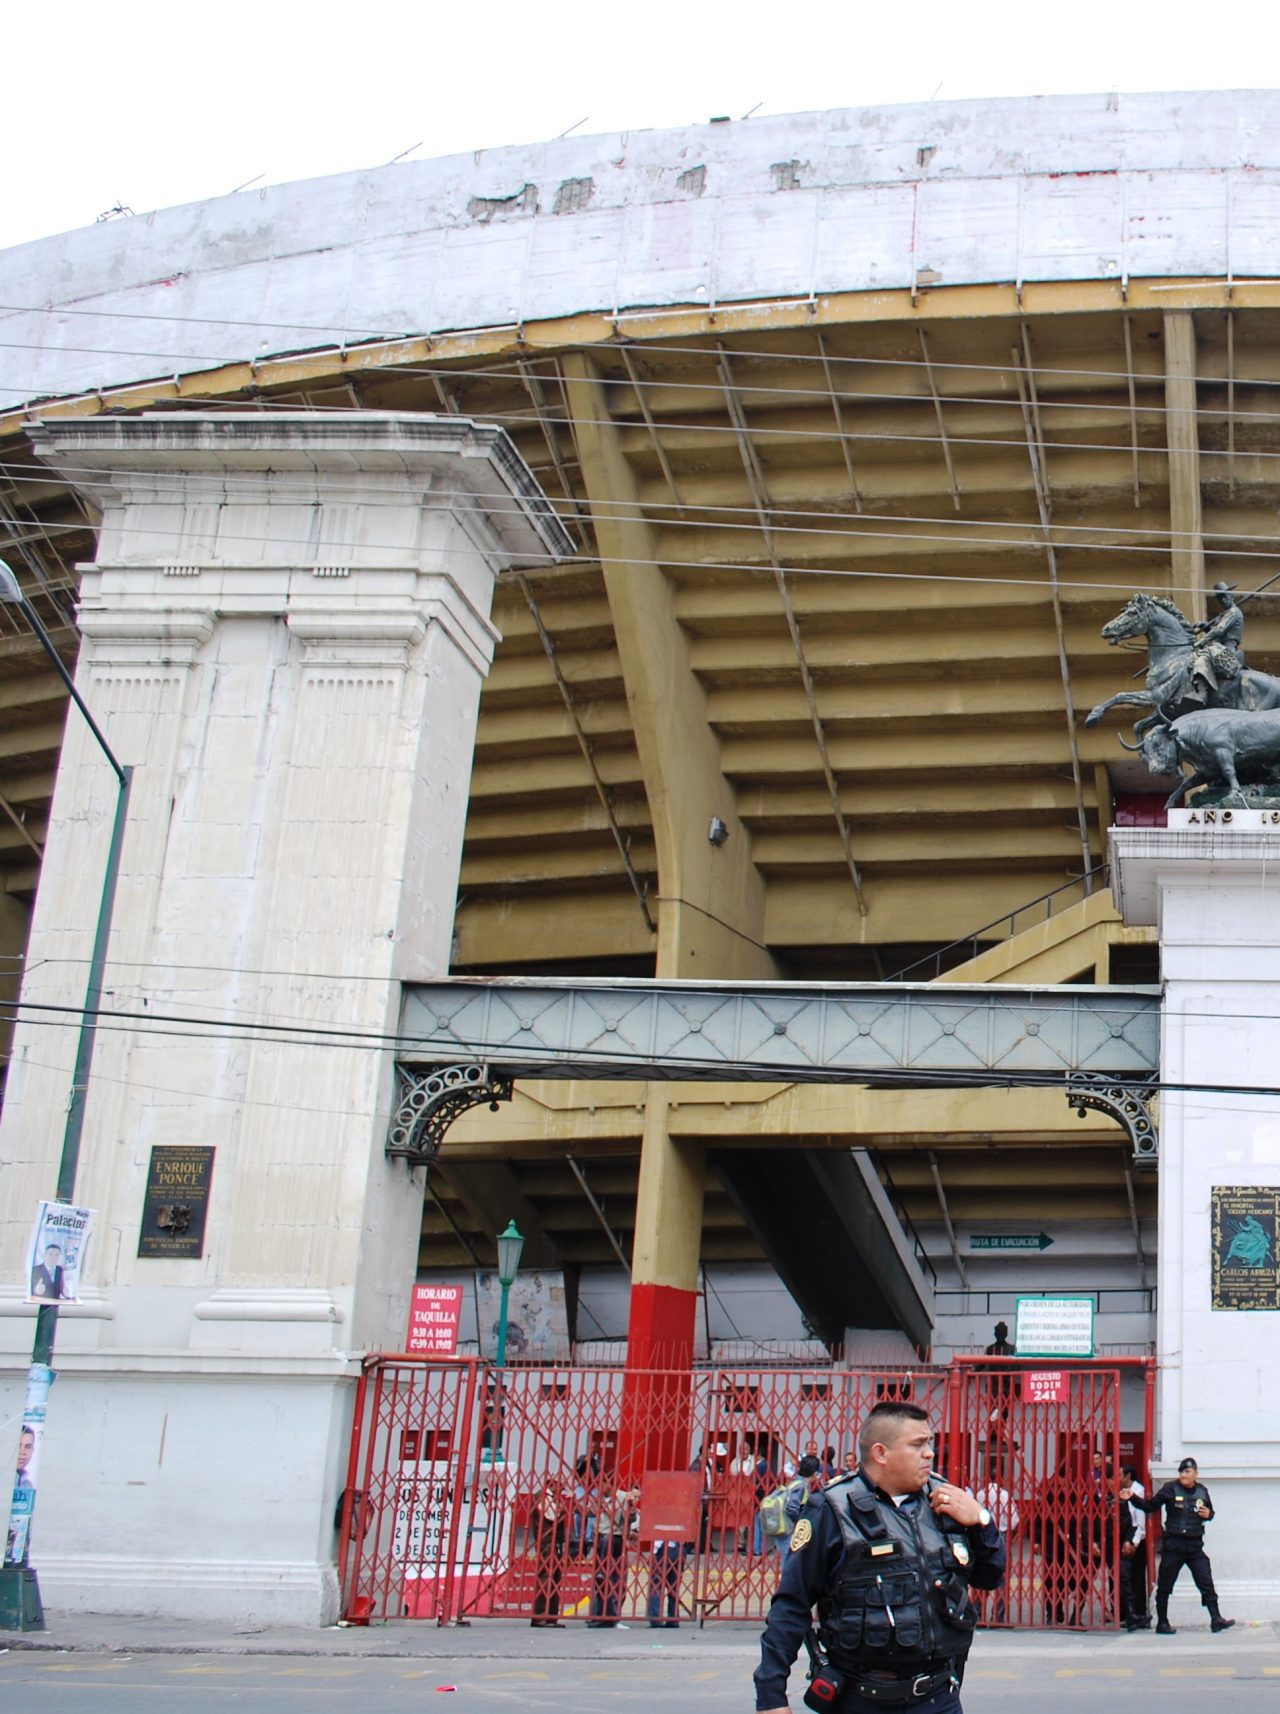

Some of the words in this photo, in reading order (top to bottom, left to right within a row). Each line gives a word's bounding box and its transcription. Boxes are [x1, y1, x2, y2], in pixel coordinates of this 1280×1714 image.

[156, 1161, 206, 1174] ENRIQUE
[158, 1173, 199, 1185] PONCE
[46, 1213, 87, 1230] Palacios
[1221, 1268, 1249, 1277] CARLOS
[1250, 1268, 1276, 1277] ARRUZA
[416, 1287, 457, 1301] HORARIO
[430, 1301, 441, 1310] DE
[415, 1310, 456, 1325] TAQUILLA
[1031, 1371, 1062, 1381] AUGUSTO
[1030, 1381, 1062, 1390] RODIN
[1033, 1390, 1057, 1401] 241
